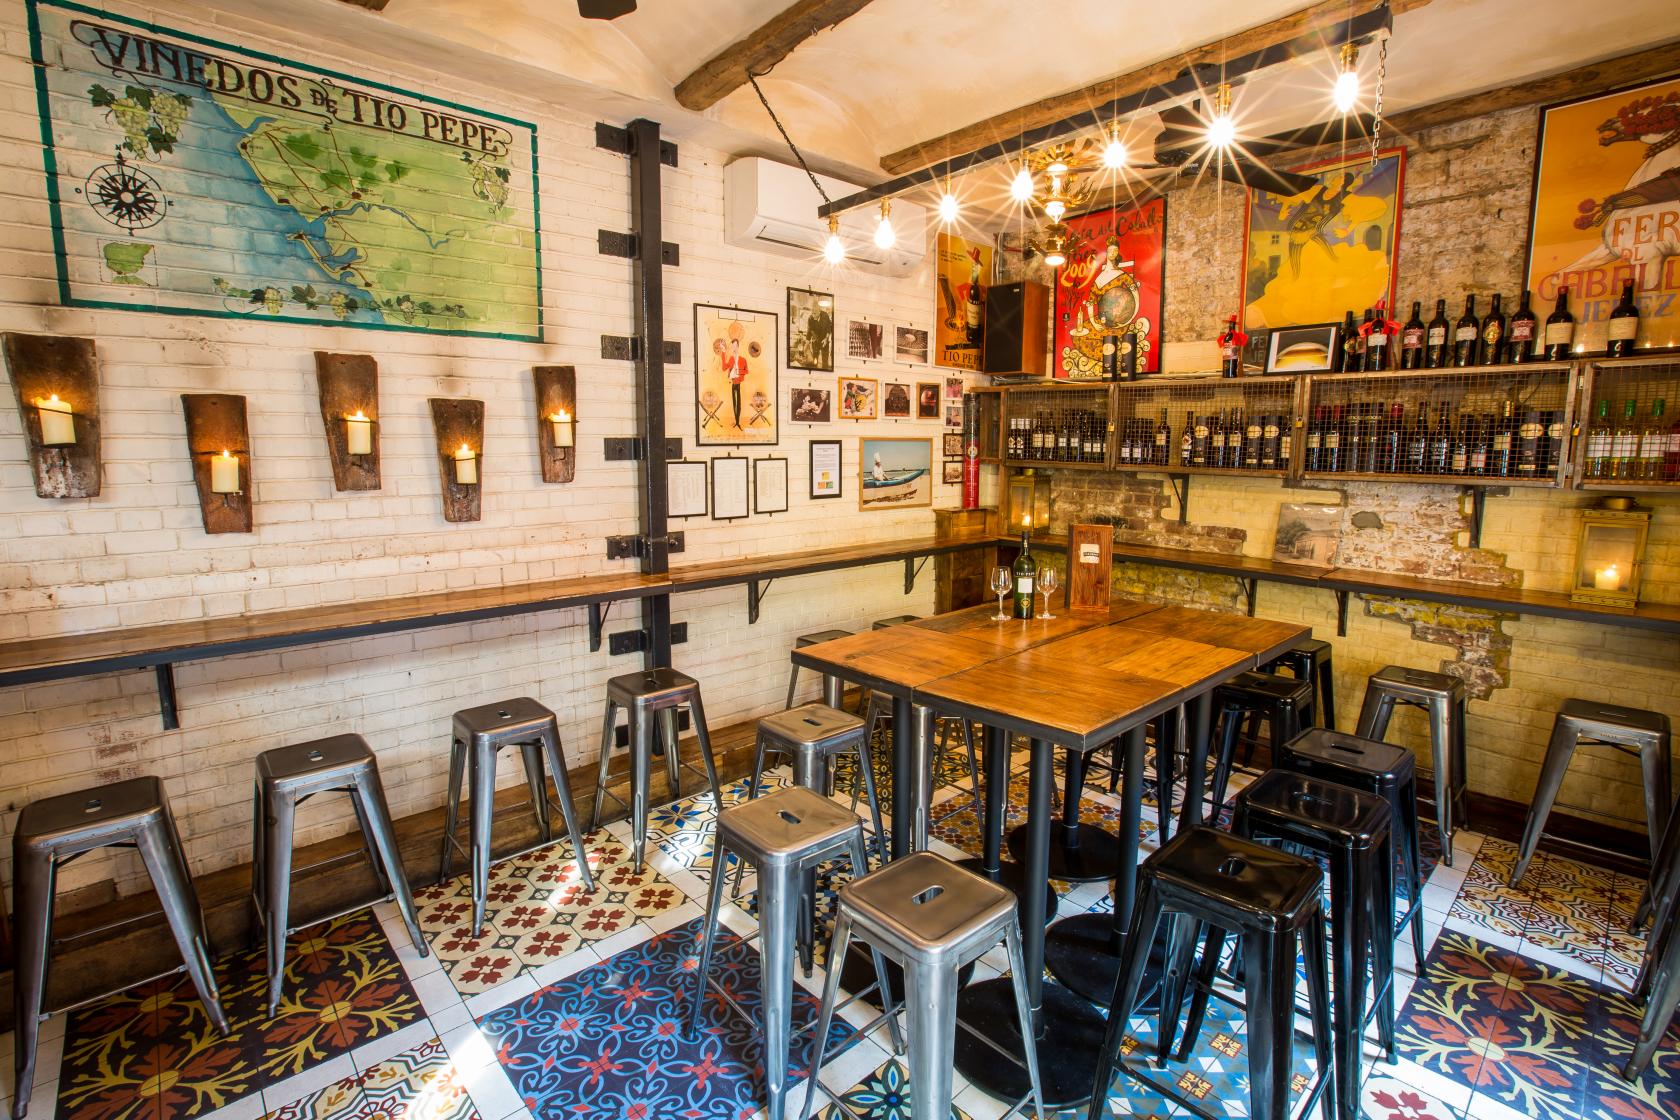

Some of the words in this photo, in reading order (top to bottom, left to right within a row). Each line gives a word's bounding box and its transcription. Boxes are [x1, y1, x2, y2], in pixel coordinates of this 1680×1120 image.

[343, 89, 407, 131] TIO
[421, 111, 499, 153] PEPE
[943, 350, 960, 362] TIO
